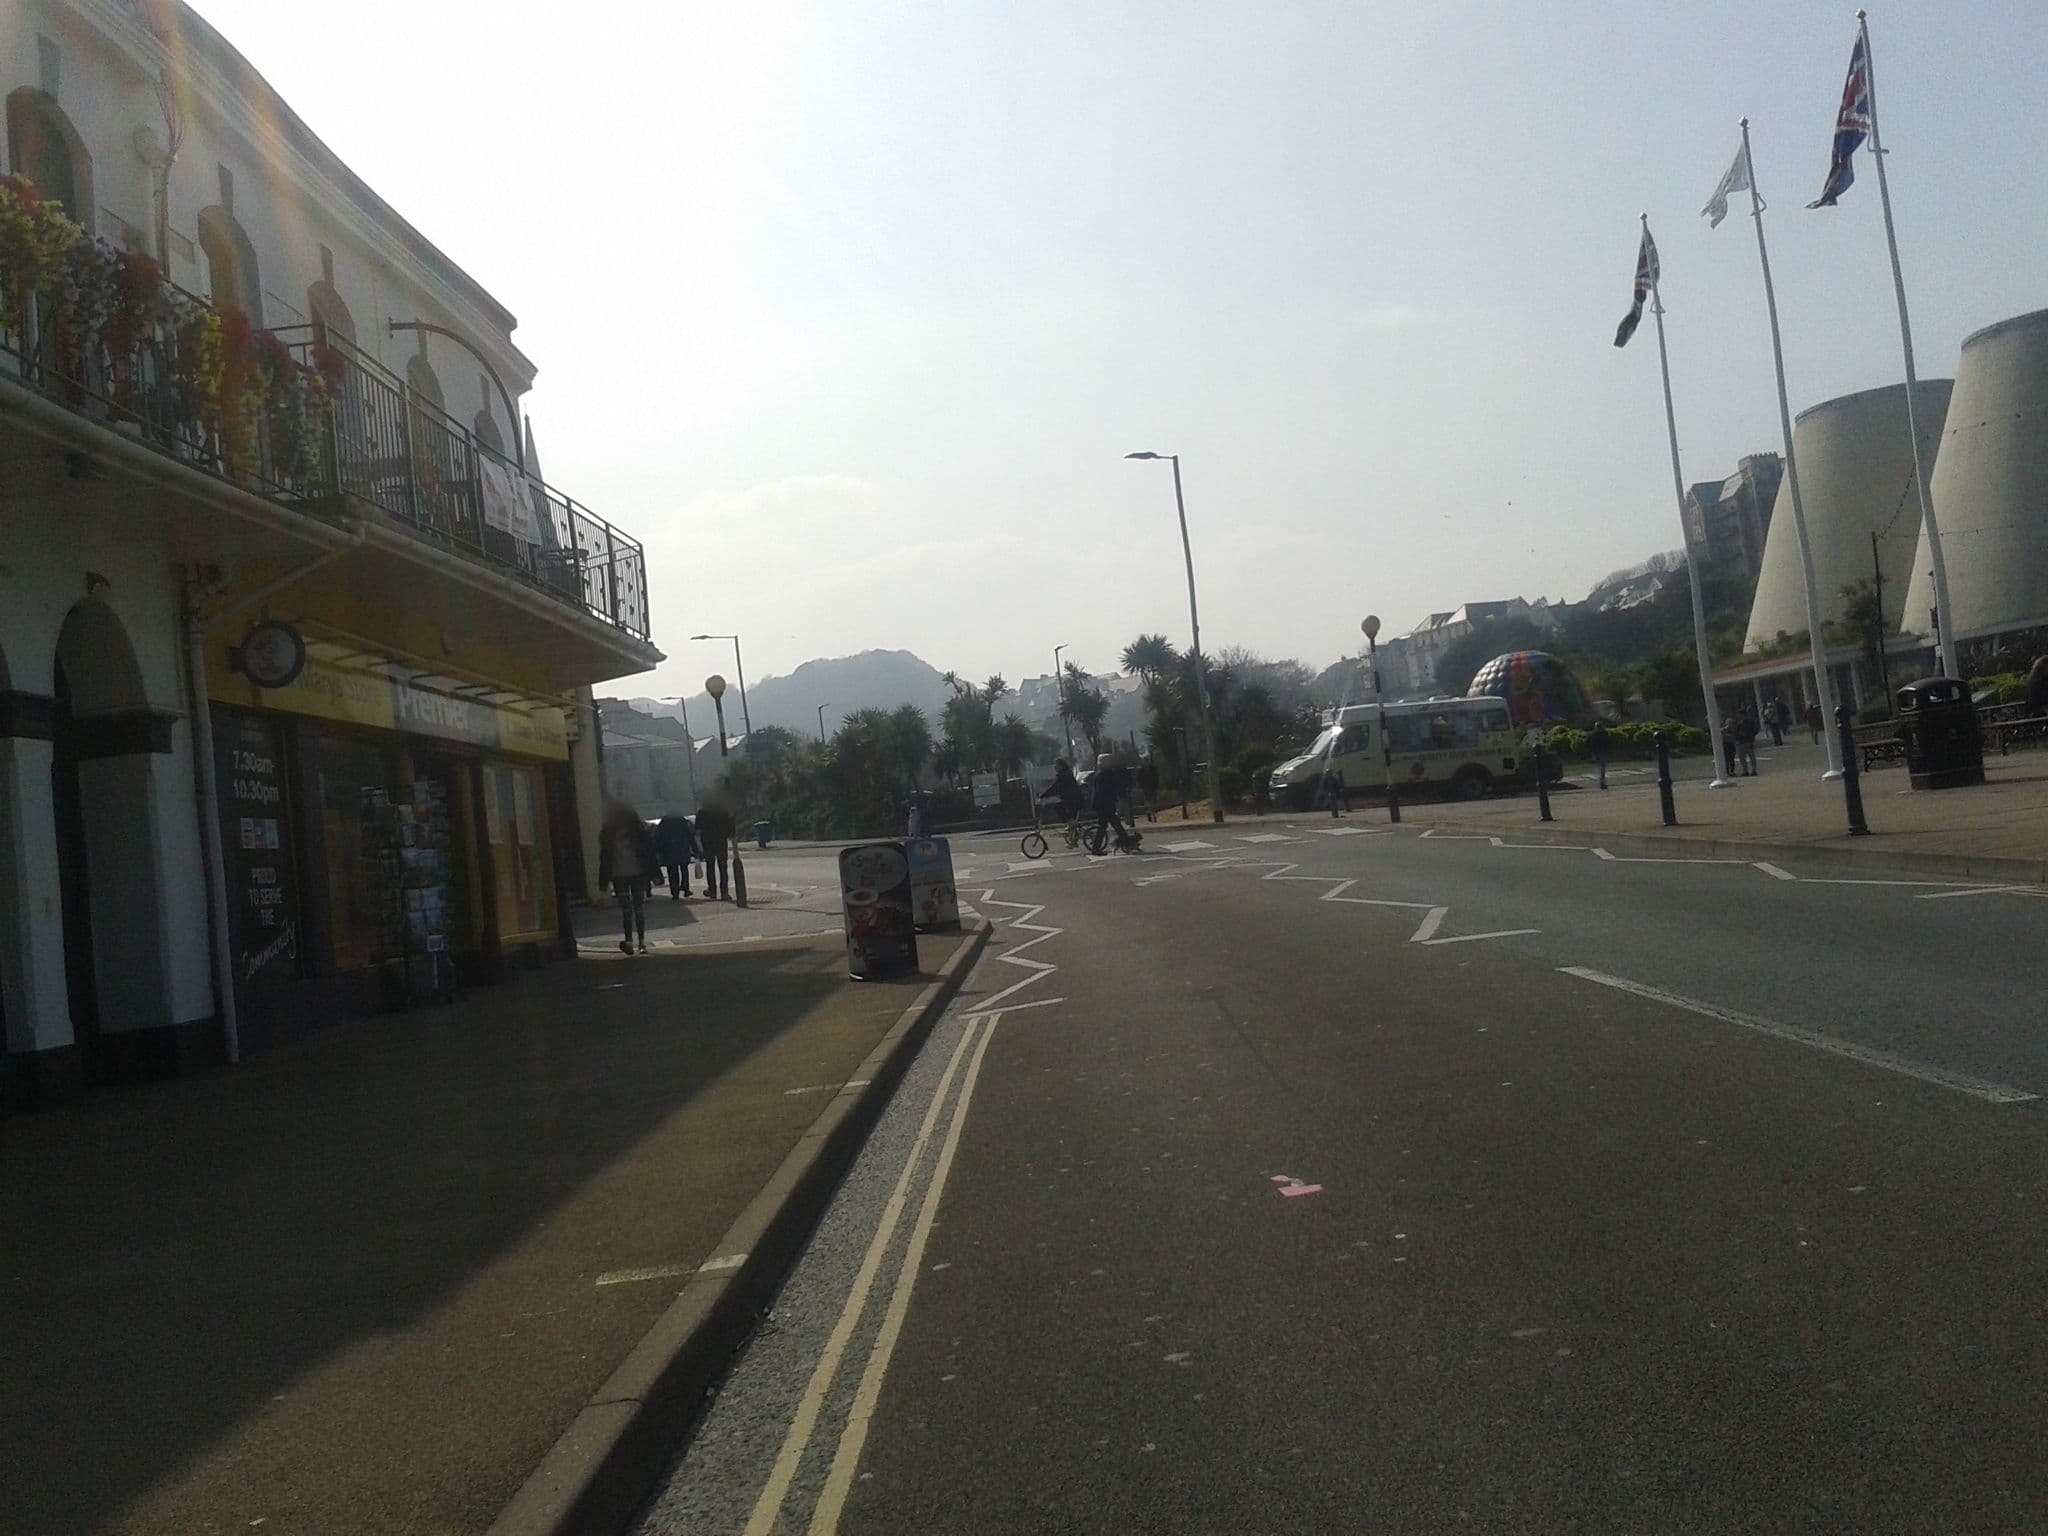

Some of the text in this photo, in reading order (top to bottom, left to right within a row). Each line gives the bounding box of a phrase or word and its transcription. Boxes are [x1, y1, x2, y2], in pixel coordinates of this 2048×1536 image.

[399, 683, 470, 730] Premier
[233, 777, 279, 805] 10.30pm
[250, 868, 277, 884] PROUD
[260, 908, 275, 926] THE
